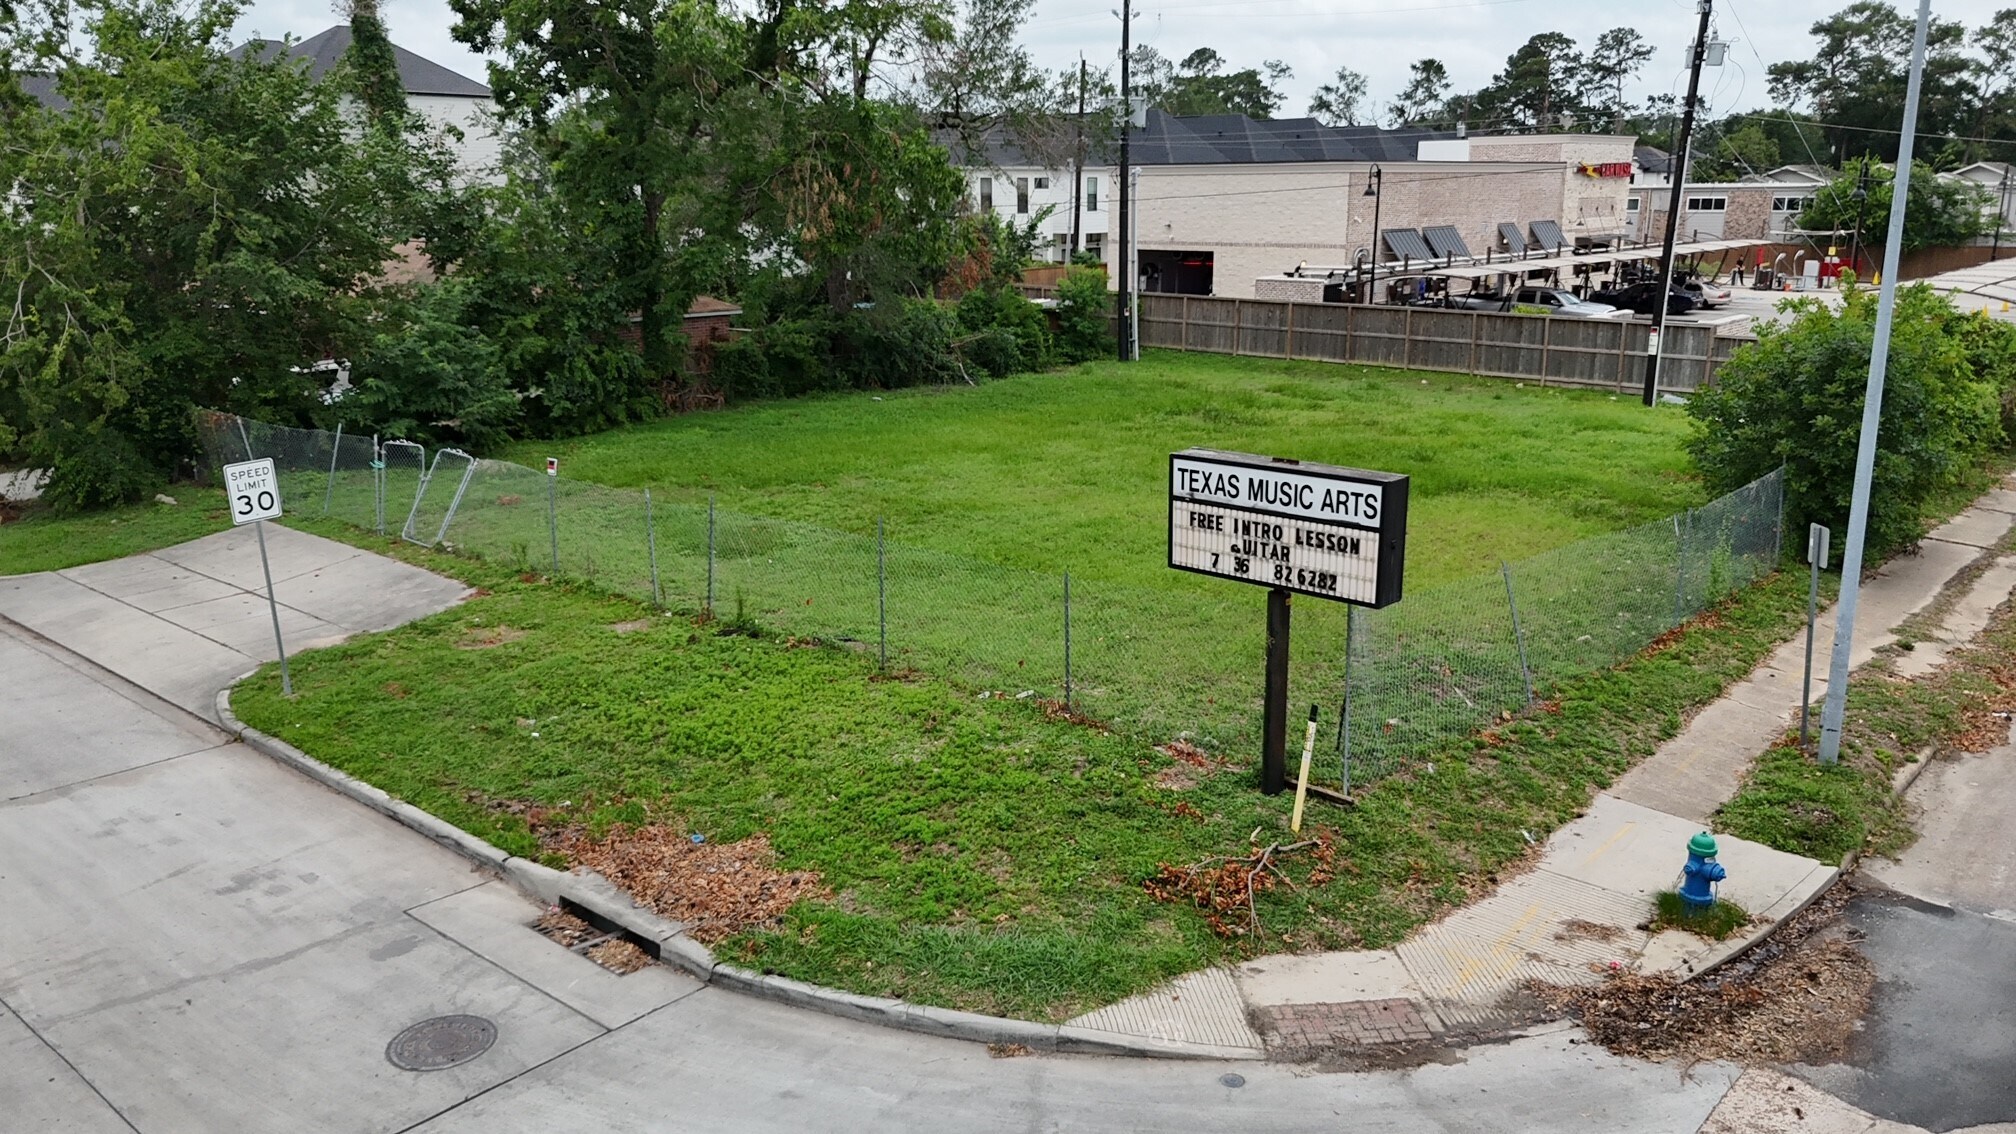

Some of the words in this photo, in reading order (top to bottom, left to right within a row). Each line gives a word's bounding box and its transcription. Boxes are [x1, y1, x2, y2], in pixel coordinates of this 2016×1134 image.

[1601, 163, 1614, 177] CAR
[231, 467, 269, 481] SPEED
[237, 479, 267, 492] LIMIT
[1177, 467, 1240, 499] TEXAS
[1248, 477, 1314, 510] MUSIC
[1320, 488, 1378, 520] ARTS
[237, 491, 274, 515] 30
[1189, 511, 1224, 532] FREE
[1233, 518, 1283, 542] INTRO
[1295, 528, 1361, 555] LESSON
[1210, 552, 1220, 569] 7
[1233, 556, 1250, 574] 36
